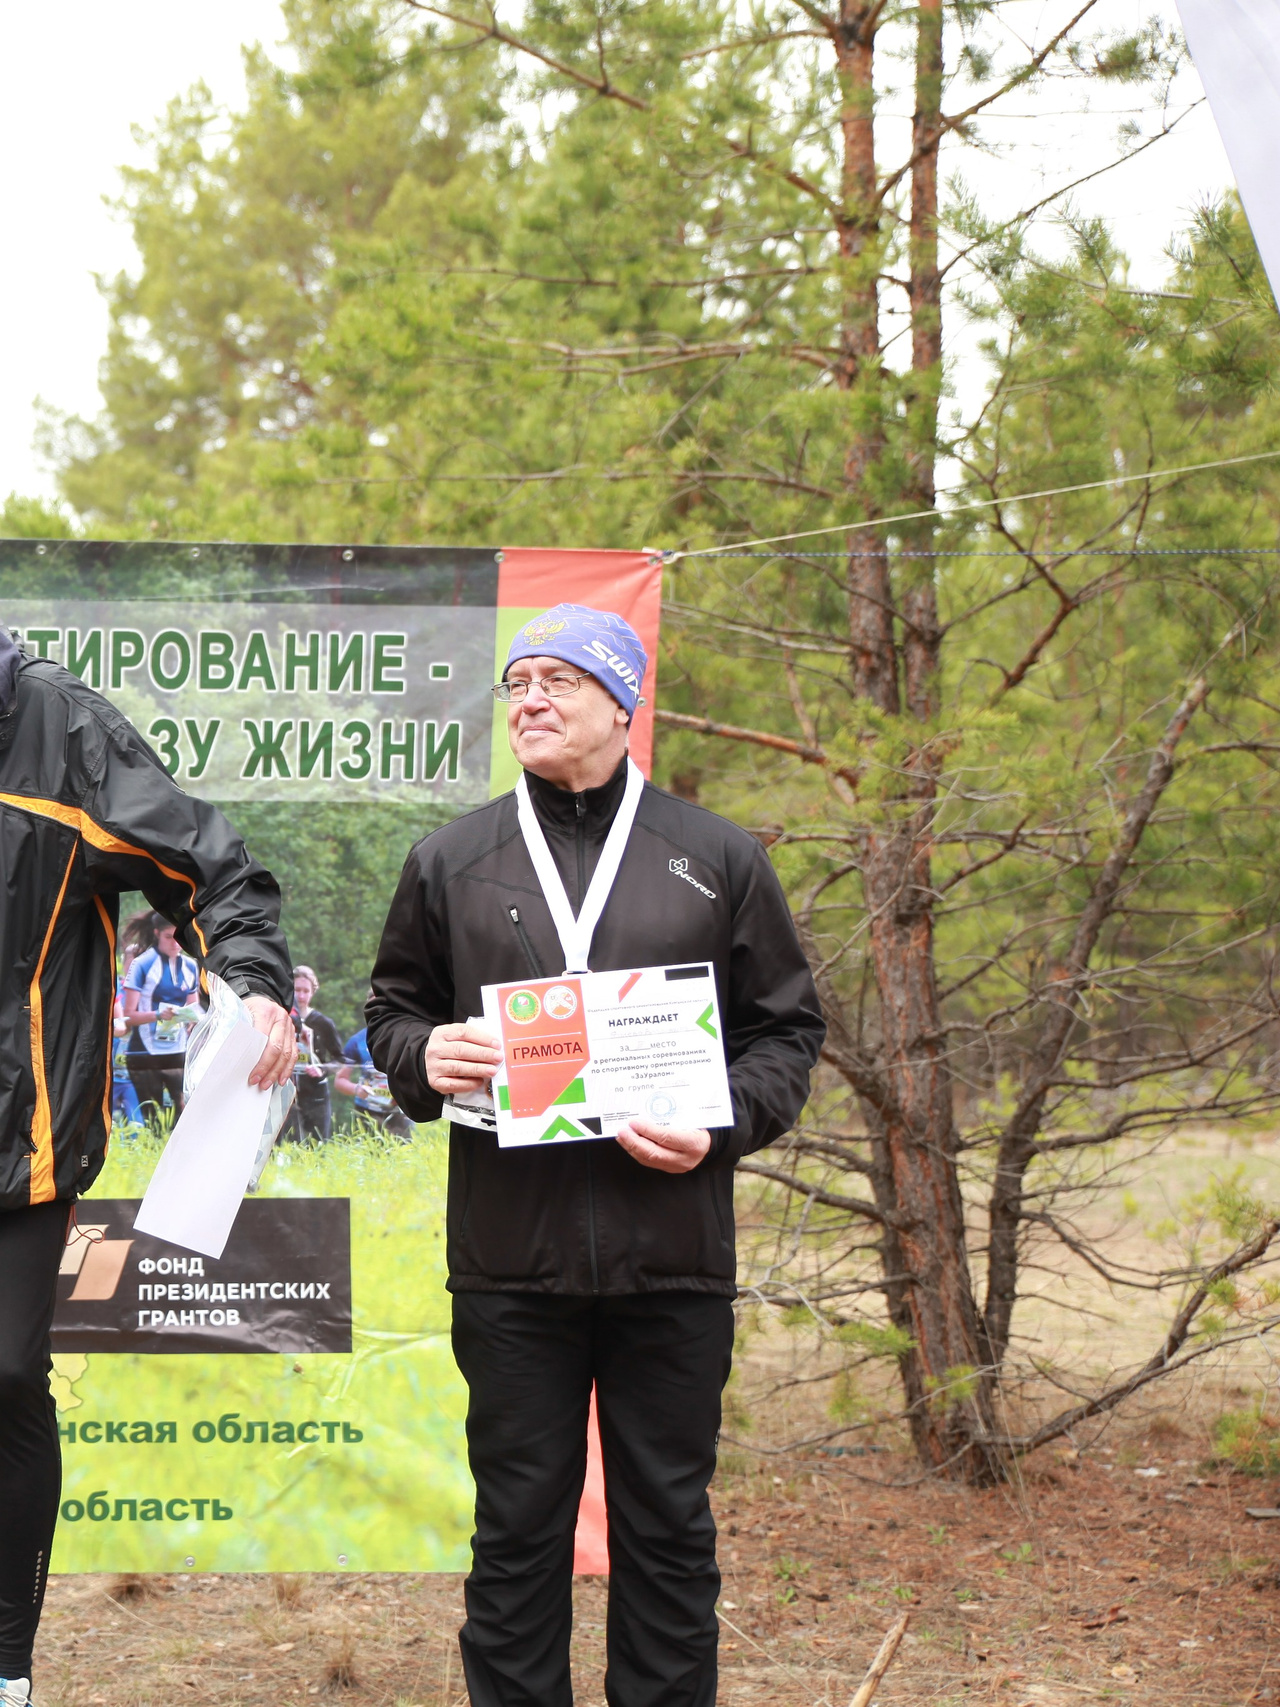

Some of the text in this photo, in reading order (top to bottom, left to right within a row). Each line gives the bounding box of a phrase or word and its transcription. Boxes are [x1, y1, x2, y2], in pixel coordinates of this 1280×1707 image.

[582, 640, 639, 698] Swix
[242, 719, 461, 780] ЖИЗНИ
[675, 870, 717, 899] NORD
[608, 1013, 679, 1028] НАГРАЖДАЕТ
[513, 1041, 583, 1060] ГРАМОТА
[600, 1054, 651, 1066] региональных
[652, 1048, 707, 1060] соревнованиях
[602, 1064, 649, 1074] спортивному
[651, 1057, 711, 1069] ориентированию
[628, 1083, 655, 1092] группе
[137, 1256, 205, 1277] ФОНД
[137, 1282, 332, 1303] ПРЕЗИДЕНТСКИХ
[137, 1309, 241, 1328] ГРАНТОВ
[192, 1413, 364, 1444] область
[60, 1490, 234, 1522] область
